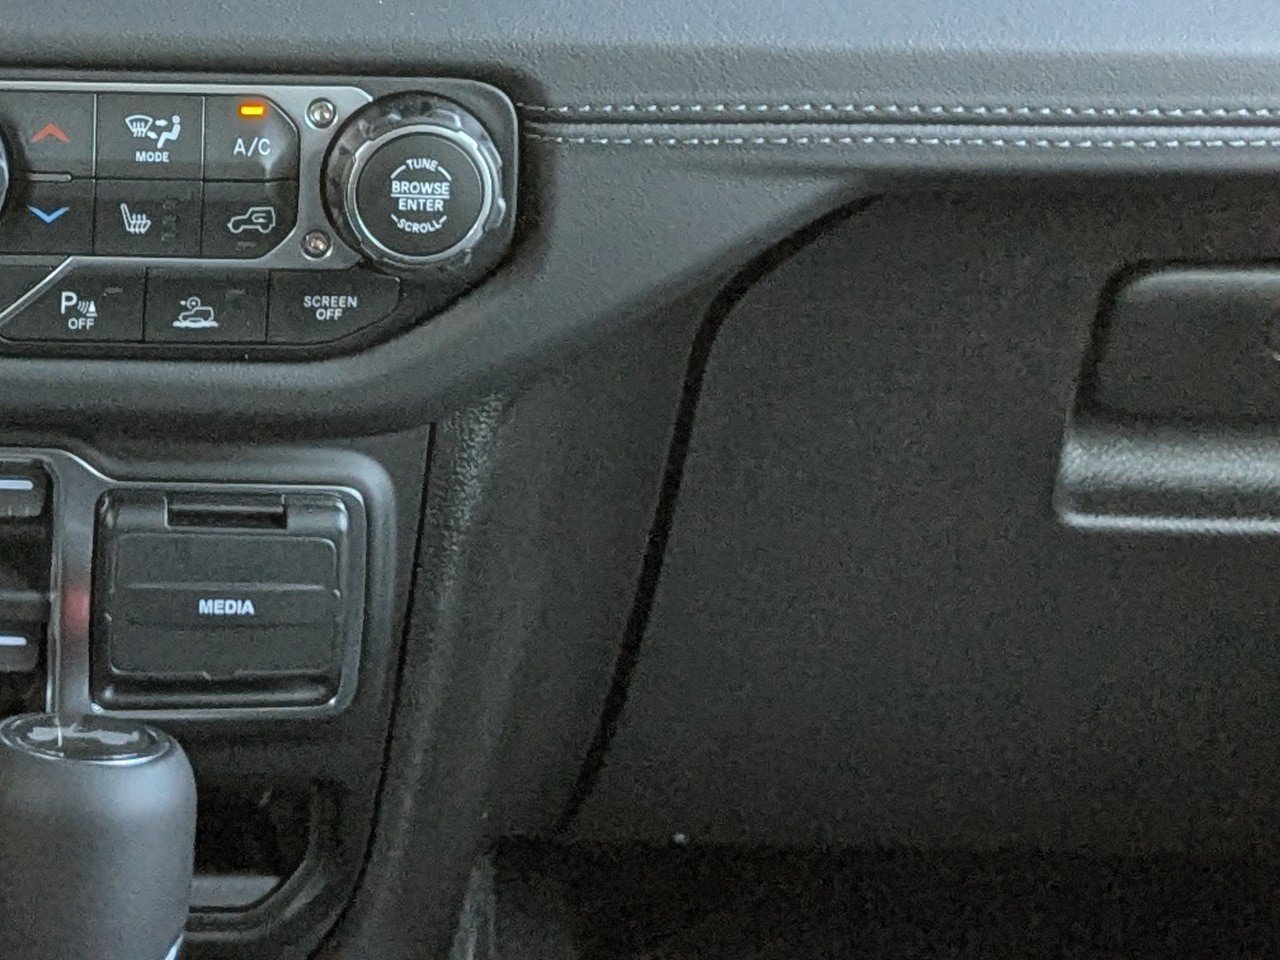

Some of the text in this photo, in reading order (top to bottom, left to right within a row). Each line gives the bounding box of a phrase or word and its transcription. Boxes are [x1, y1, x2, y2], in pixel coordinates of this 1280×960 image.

[233, 138, 272, 157] A/C
[135, 151, 170, 164] MODE
[405, 158, 440, 173] TUNE
[391, 180, 451, 195] BROWSE
[398, 198, 444, 213] ENTER
[396, 216, 445, 234] SCROLL
[60, 292, 77, 314] P
[303, 295, 358, 310] SCREEN
[315, 307, 343, 321] OFF
[68, 316, 95, 330] OFF
[198, 599, 255, 616] MEDIA
